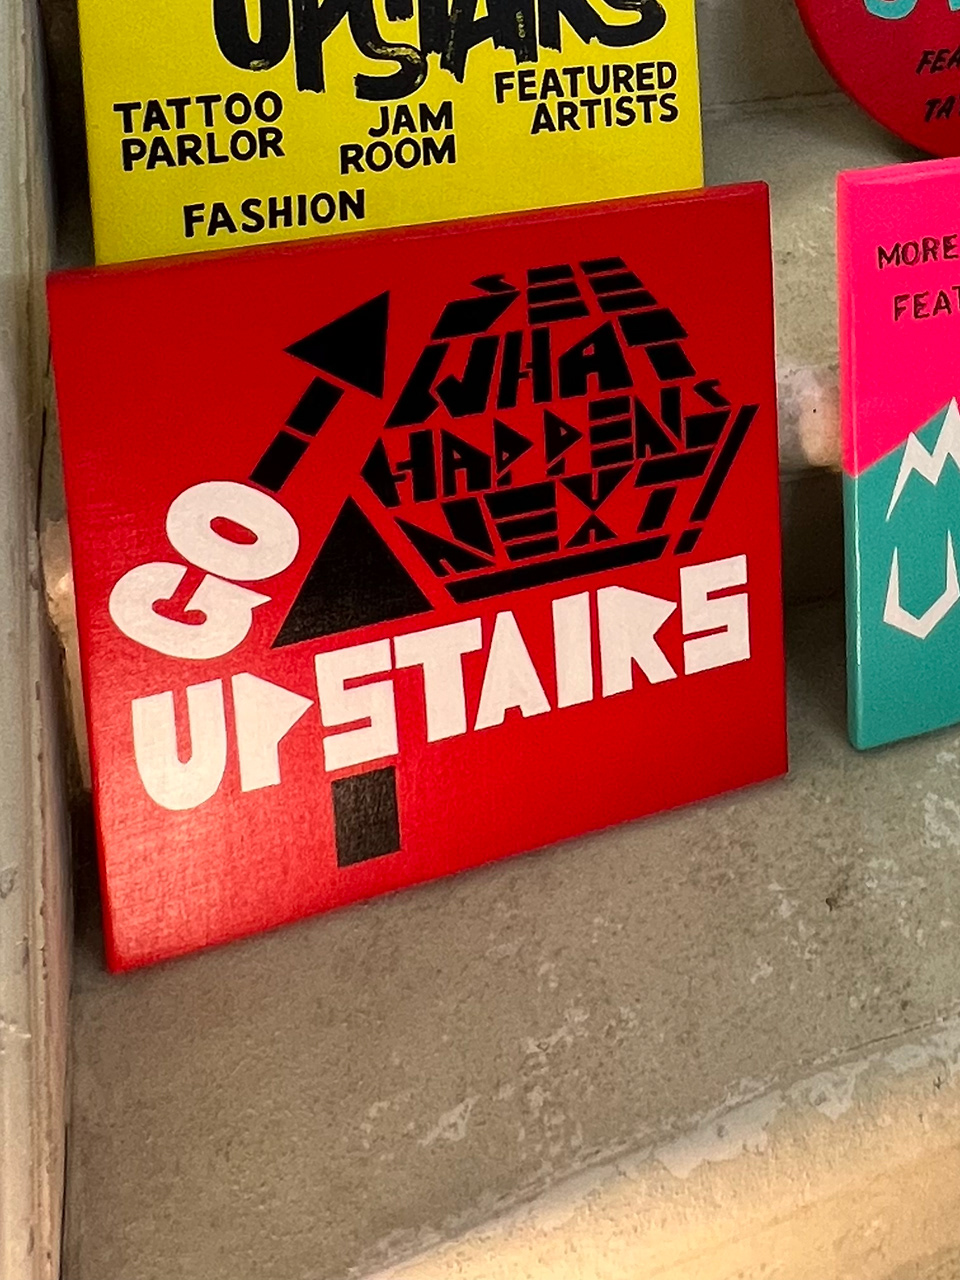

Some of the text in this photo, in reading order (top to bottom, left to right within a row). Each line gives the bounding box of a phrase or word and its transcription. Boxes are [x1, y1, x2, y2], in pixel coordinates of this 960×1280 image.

[495, 61, 678, 103] FEATURED
[114, 90, 283, 134] TATTOO
[368, 101, 454, 138] JAM
[531, 95, 678, 135] ARTISTS
[122, 127, 285, 171] PARLOR
[339, 134, 457, 174] ROOM
[183, 189, 366, 237] FASHION
[876, 234, 959, 270] MORE
[383, 308, 696, 429] WHAT
[108, 481, 299, 660] GO
[131, 554, 751, 811] UPSTAIRS
